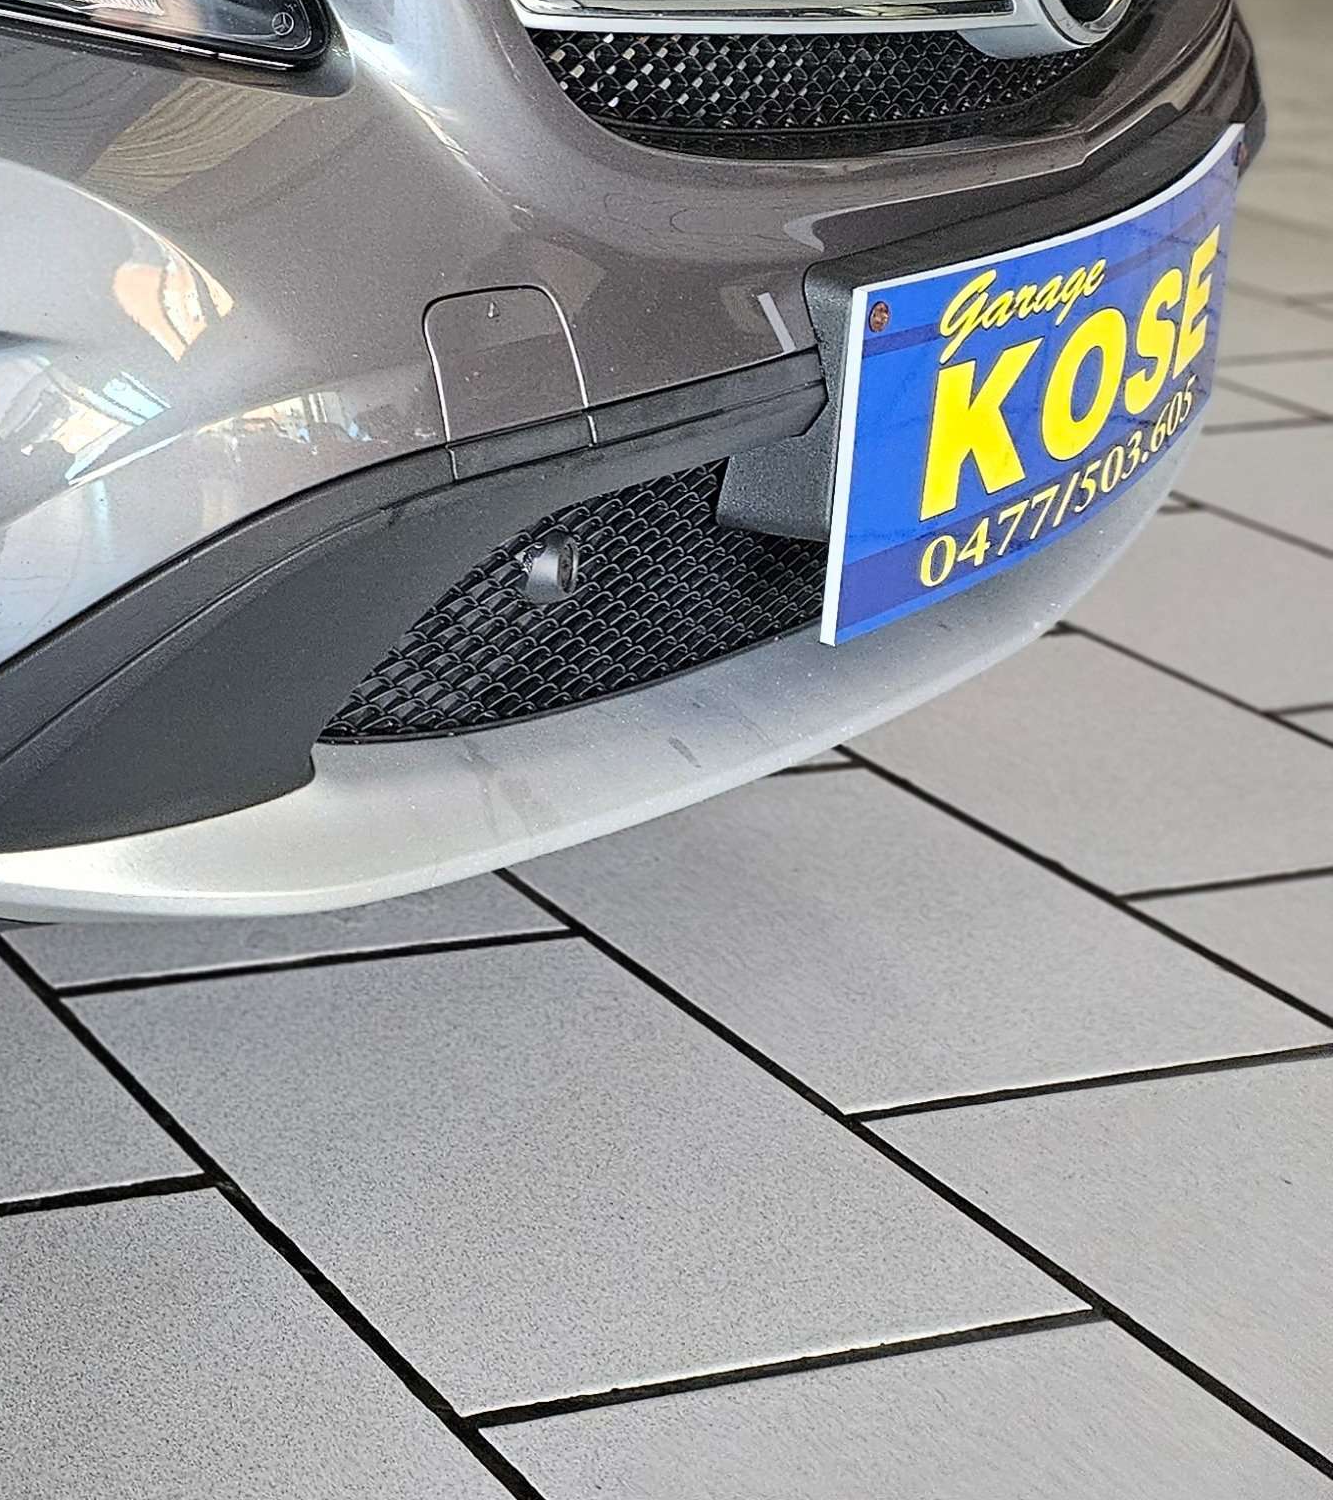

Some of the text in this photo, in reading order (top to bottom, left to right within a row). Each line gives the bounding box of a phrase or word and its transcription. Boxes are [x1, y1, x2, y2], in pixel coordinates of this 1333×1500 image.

[919, 225, 1221, 522] KOSE
[939, 257, 1108, 363] Garage
[919, 377, 1196, 588] 0477/503.605
